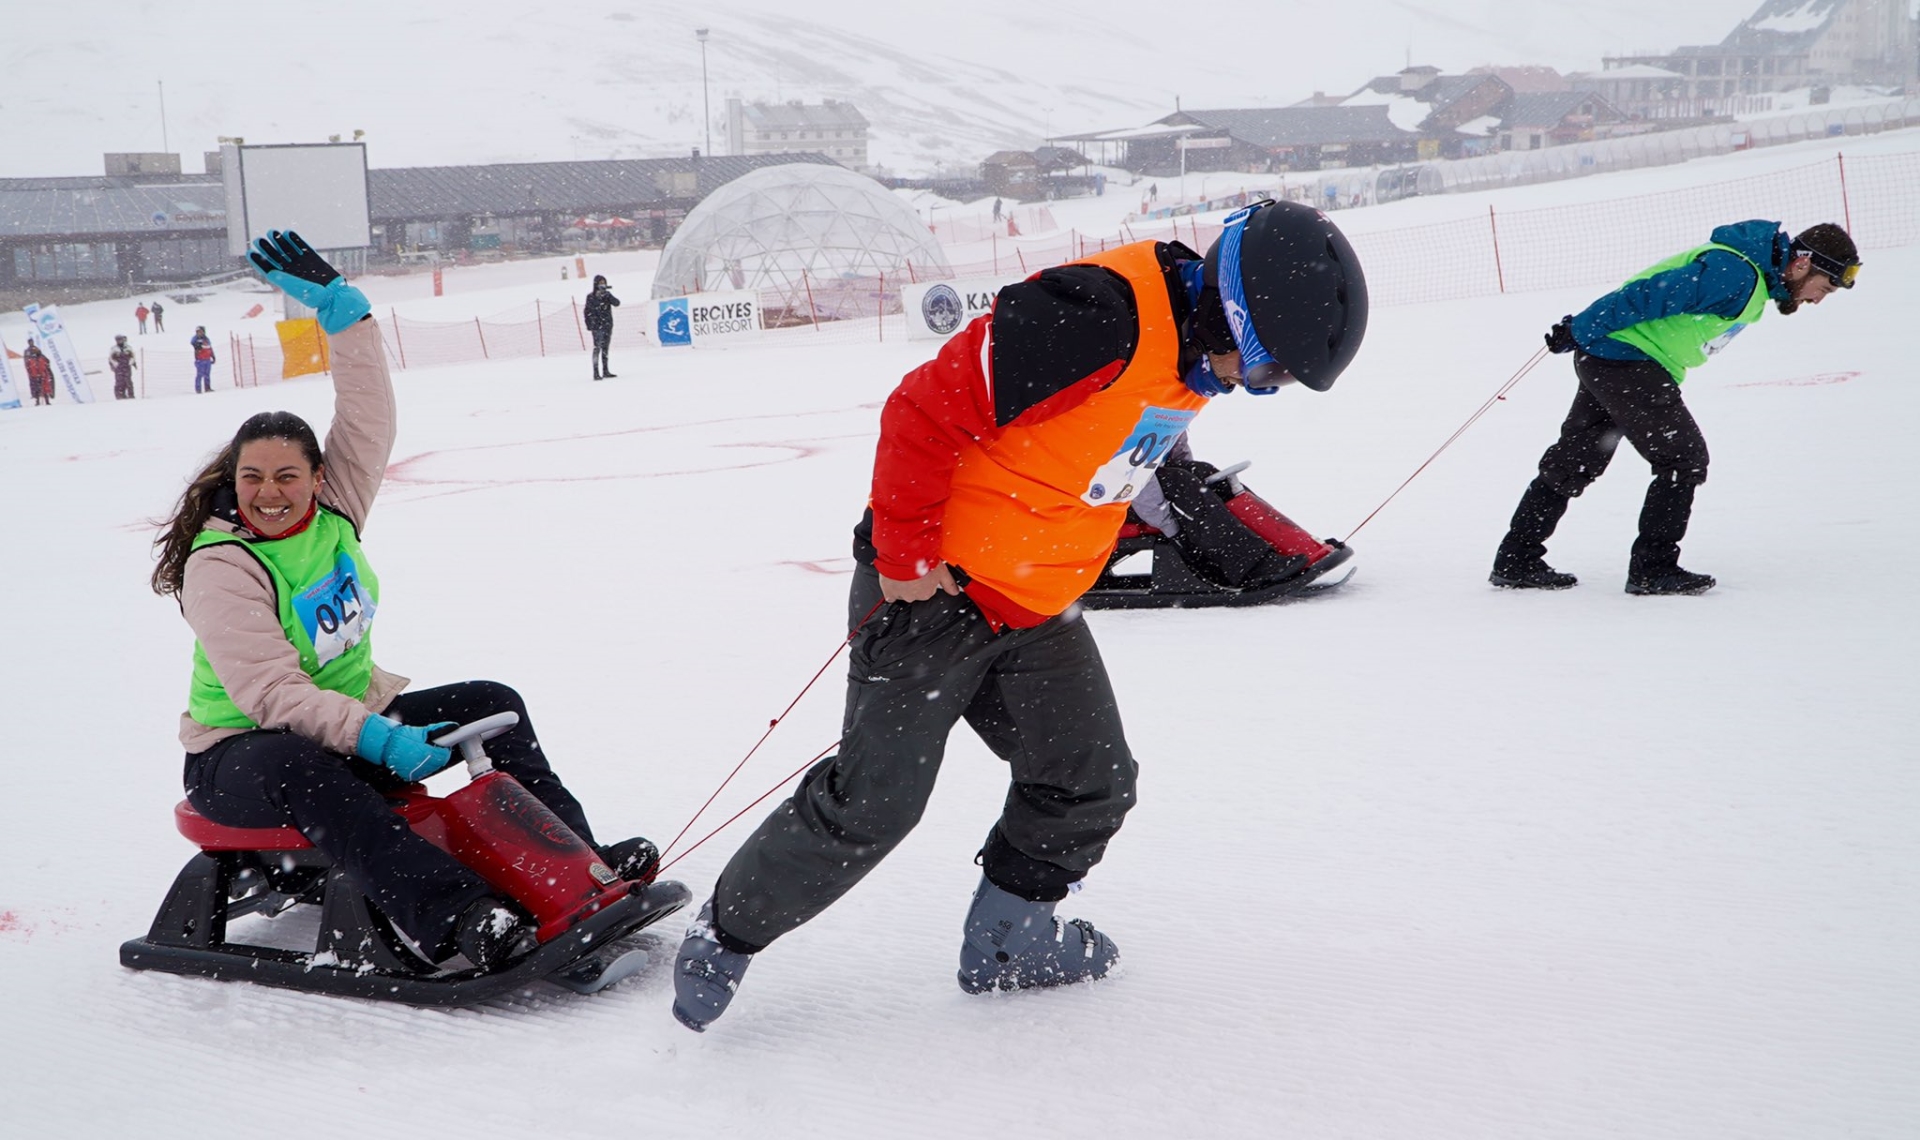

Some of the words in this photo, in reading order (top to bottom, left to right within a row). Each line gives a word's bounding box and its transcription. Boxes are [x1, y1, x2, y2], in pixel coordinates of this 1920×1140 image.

[694, 321, 711, 336] SKI
[712, 318, 753, 334] RESORT
[315, 576, 362, 635] 027
